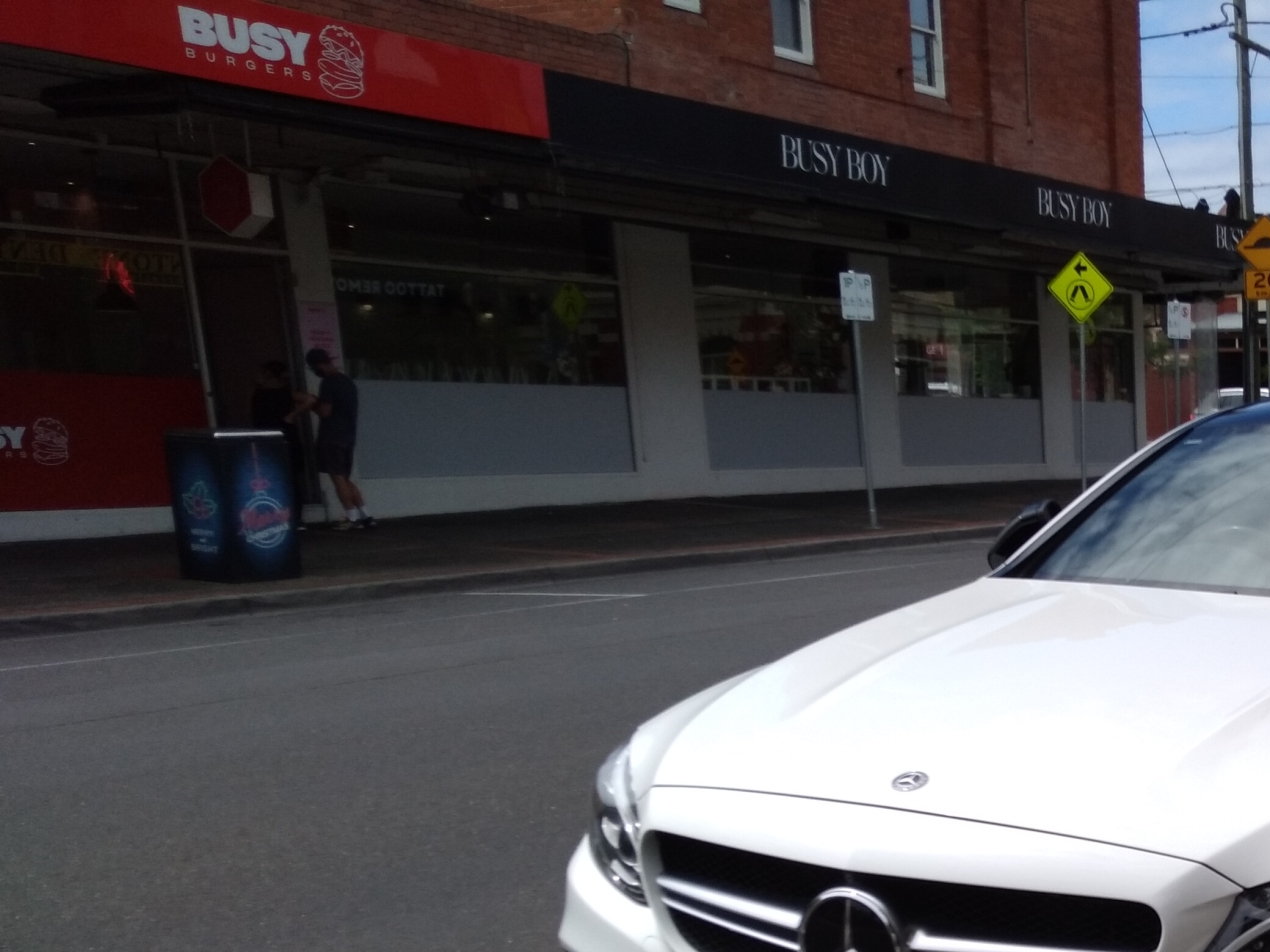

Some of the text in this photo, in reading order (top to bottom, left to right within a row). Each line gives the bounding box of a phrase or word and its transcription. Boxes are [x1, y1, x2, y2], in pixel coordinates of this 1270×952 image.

[177, 5, 311, 66] BUSY
[185, 47, 312, 81] BURGERS
[780, 133, 892, 187] BUSY BOY
[1037, 186, 1113, 229] BUSY BOY
[0, 426, 26, 449] Y
